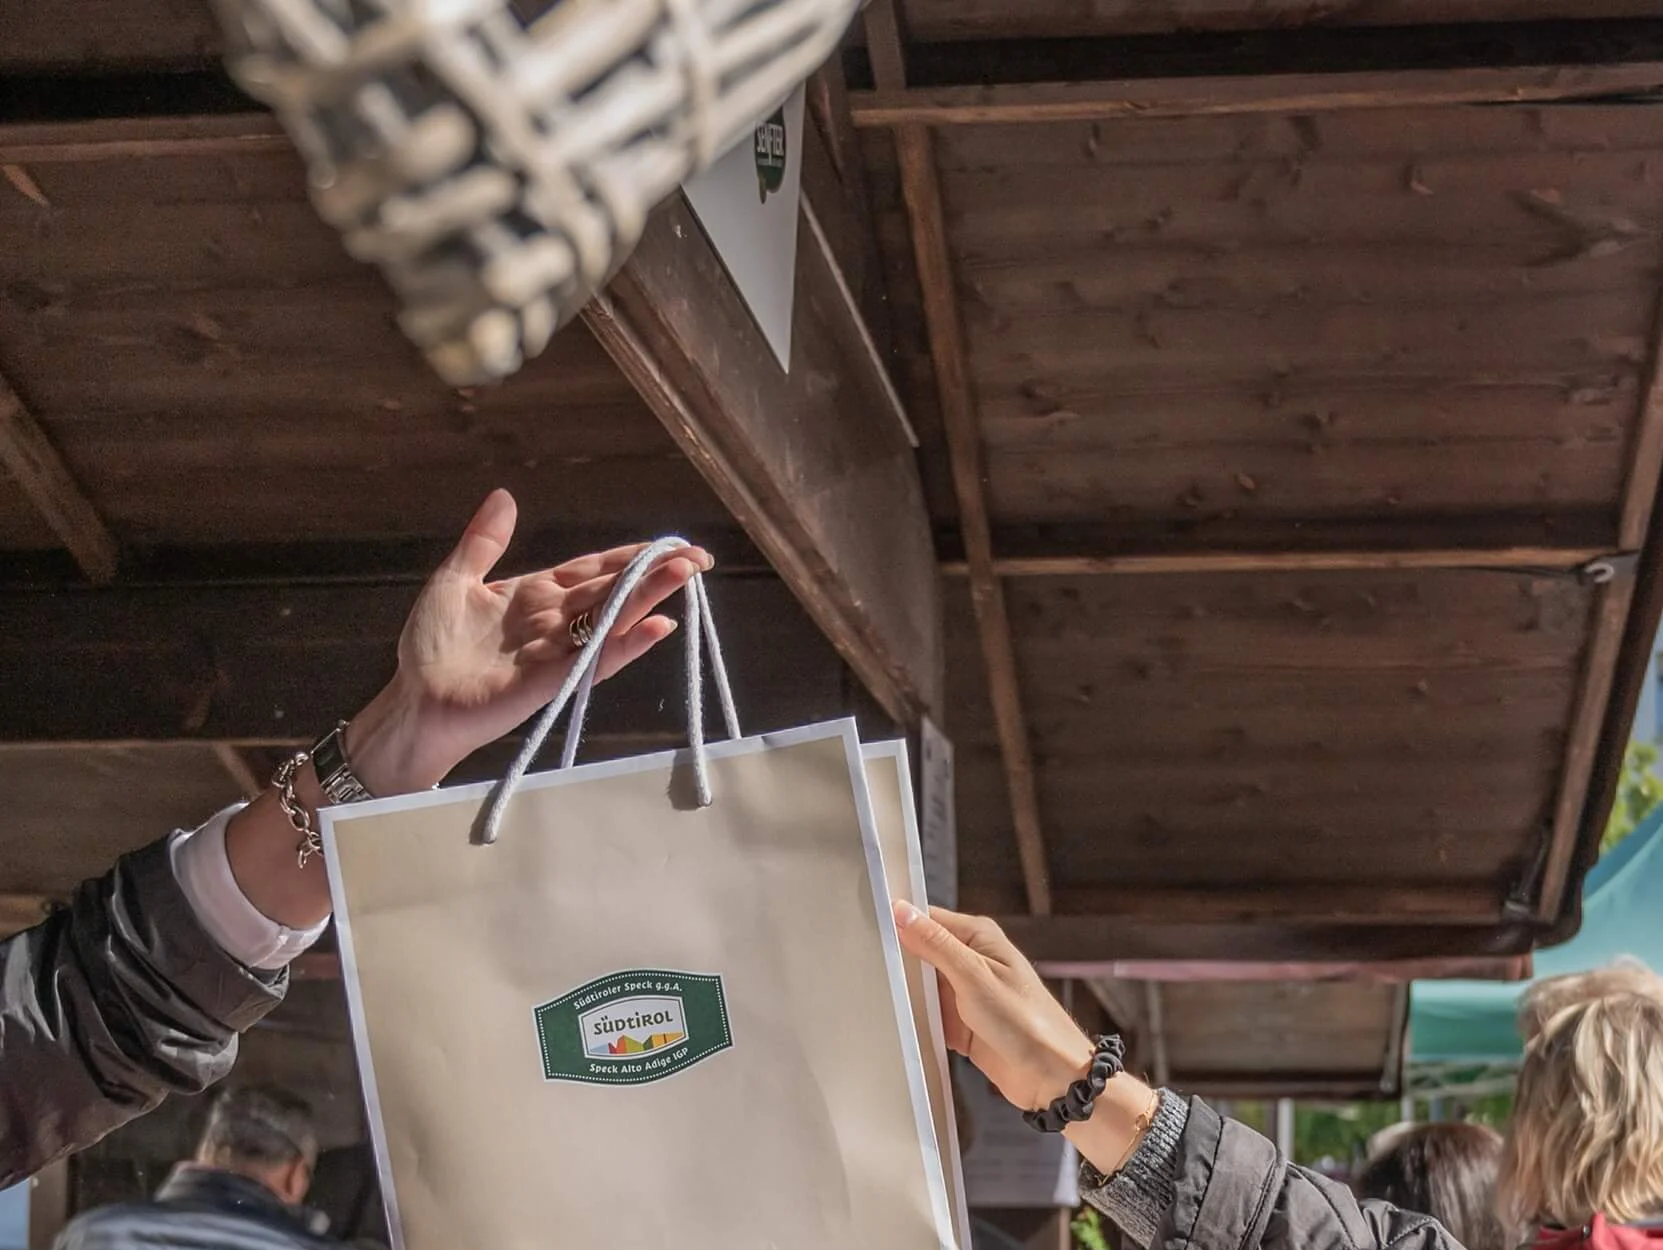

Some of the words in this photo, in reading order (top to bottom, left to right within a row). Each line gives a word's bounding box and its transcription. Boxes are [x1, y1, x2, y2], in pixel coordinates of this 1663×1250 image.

[573, 985, 621, 1010] Südtiroler
[624, 981, 653, 992] Speck
[655, 982, 683, 992] g.g.A.
[589, 1063, 618, 1074] Speck
[621, 1064, 642, 1073] Alto
[645, 1056, 671, 1070] Adige
[673, 1047, 689, 1060] IGP
